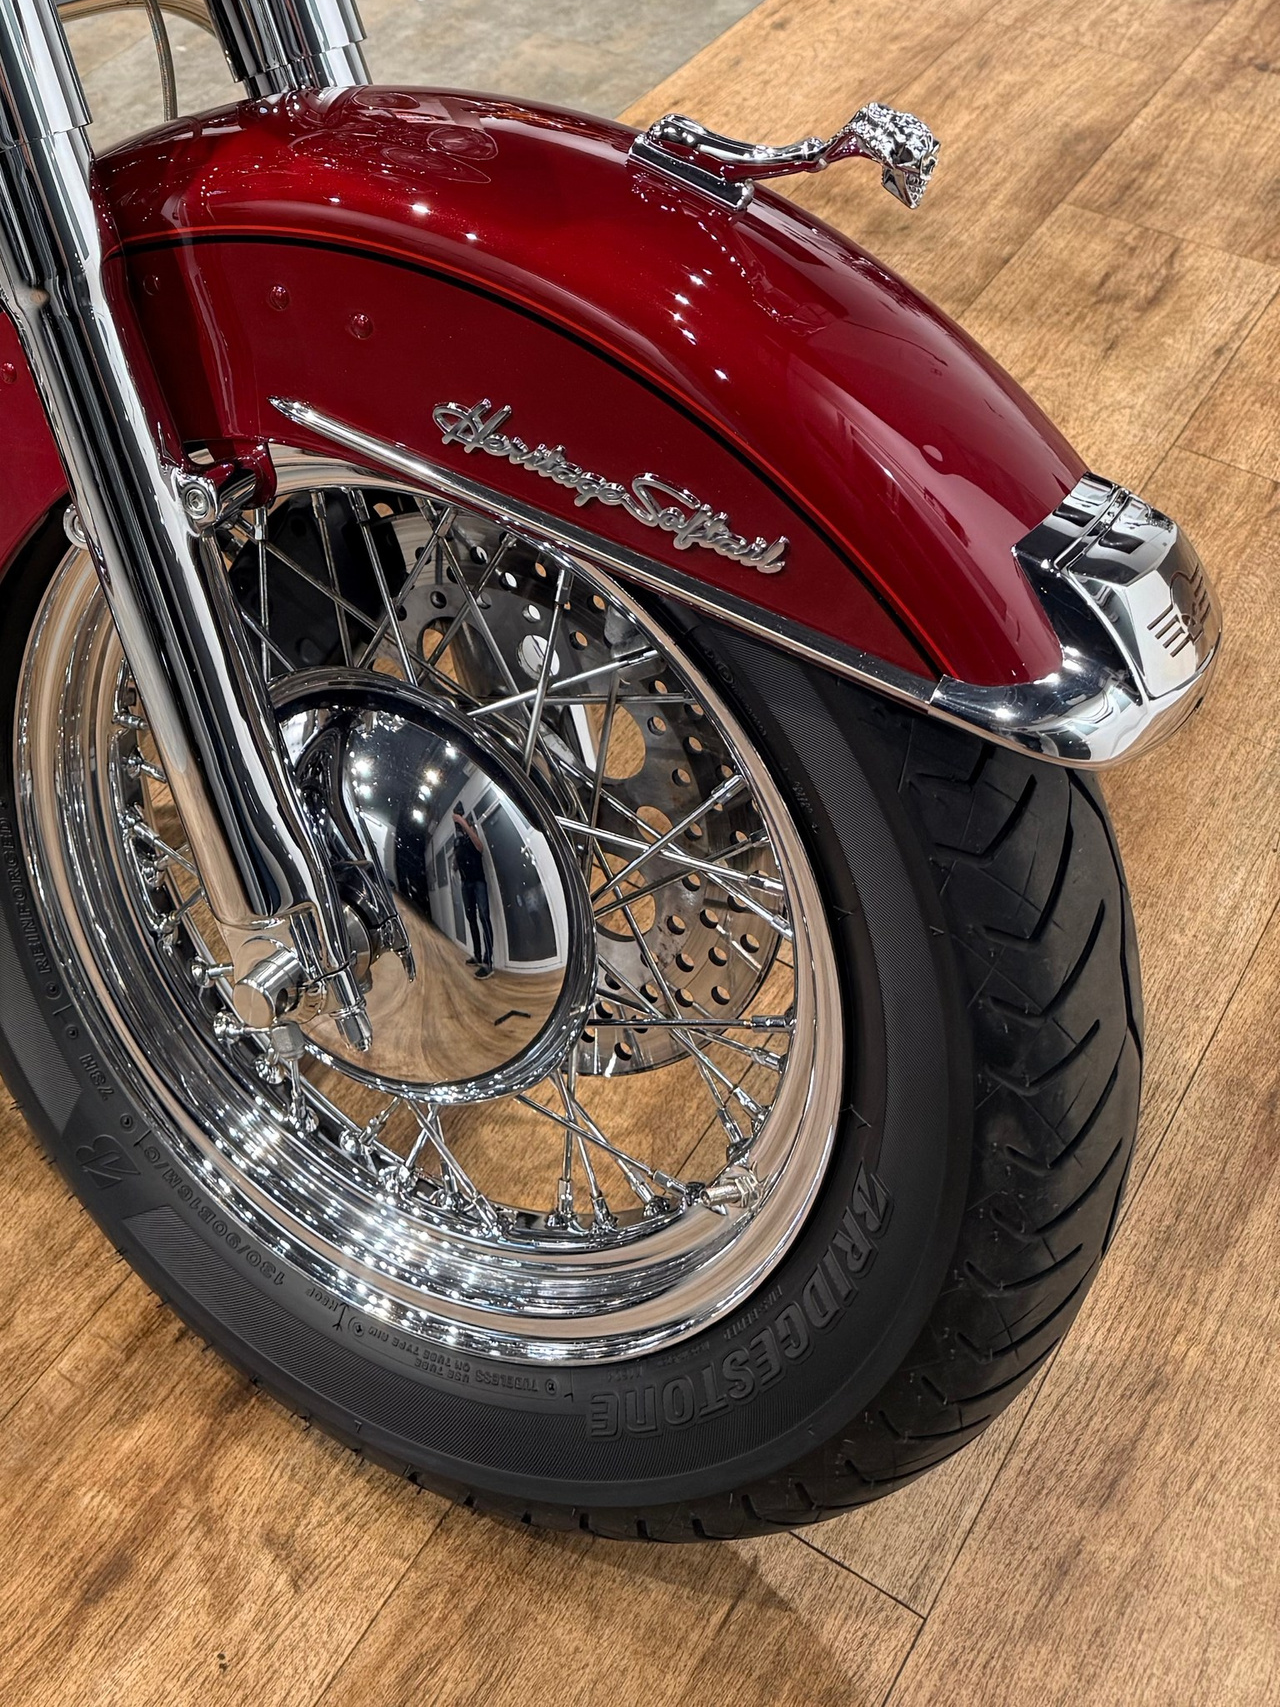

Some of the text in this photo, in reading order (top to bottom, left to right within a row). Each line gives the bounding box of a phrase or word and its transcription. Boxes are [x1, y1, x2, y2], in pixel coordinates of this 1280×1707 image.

[432, 398, 791, 574] Heritage Softail
[79, 1053, 115, 1095] 73H
[590, 1160, 893, 1438] BRIDGESTONE
[391, 1337, 420, 1358] TYPE
[422, 1349, 452, 1367] TUBE
[413, 1357, 444, 1378] TUBE
[475, 1369, 539, 1393] TUBELESS
